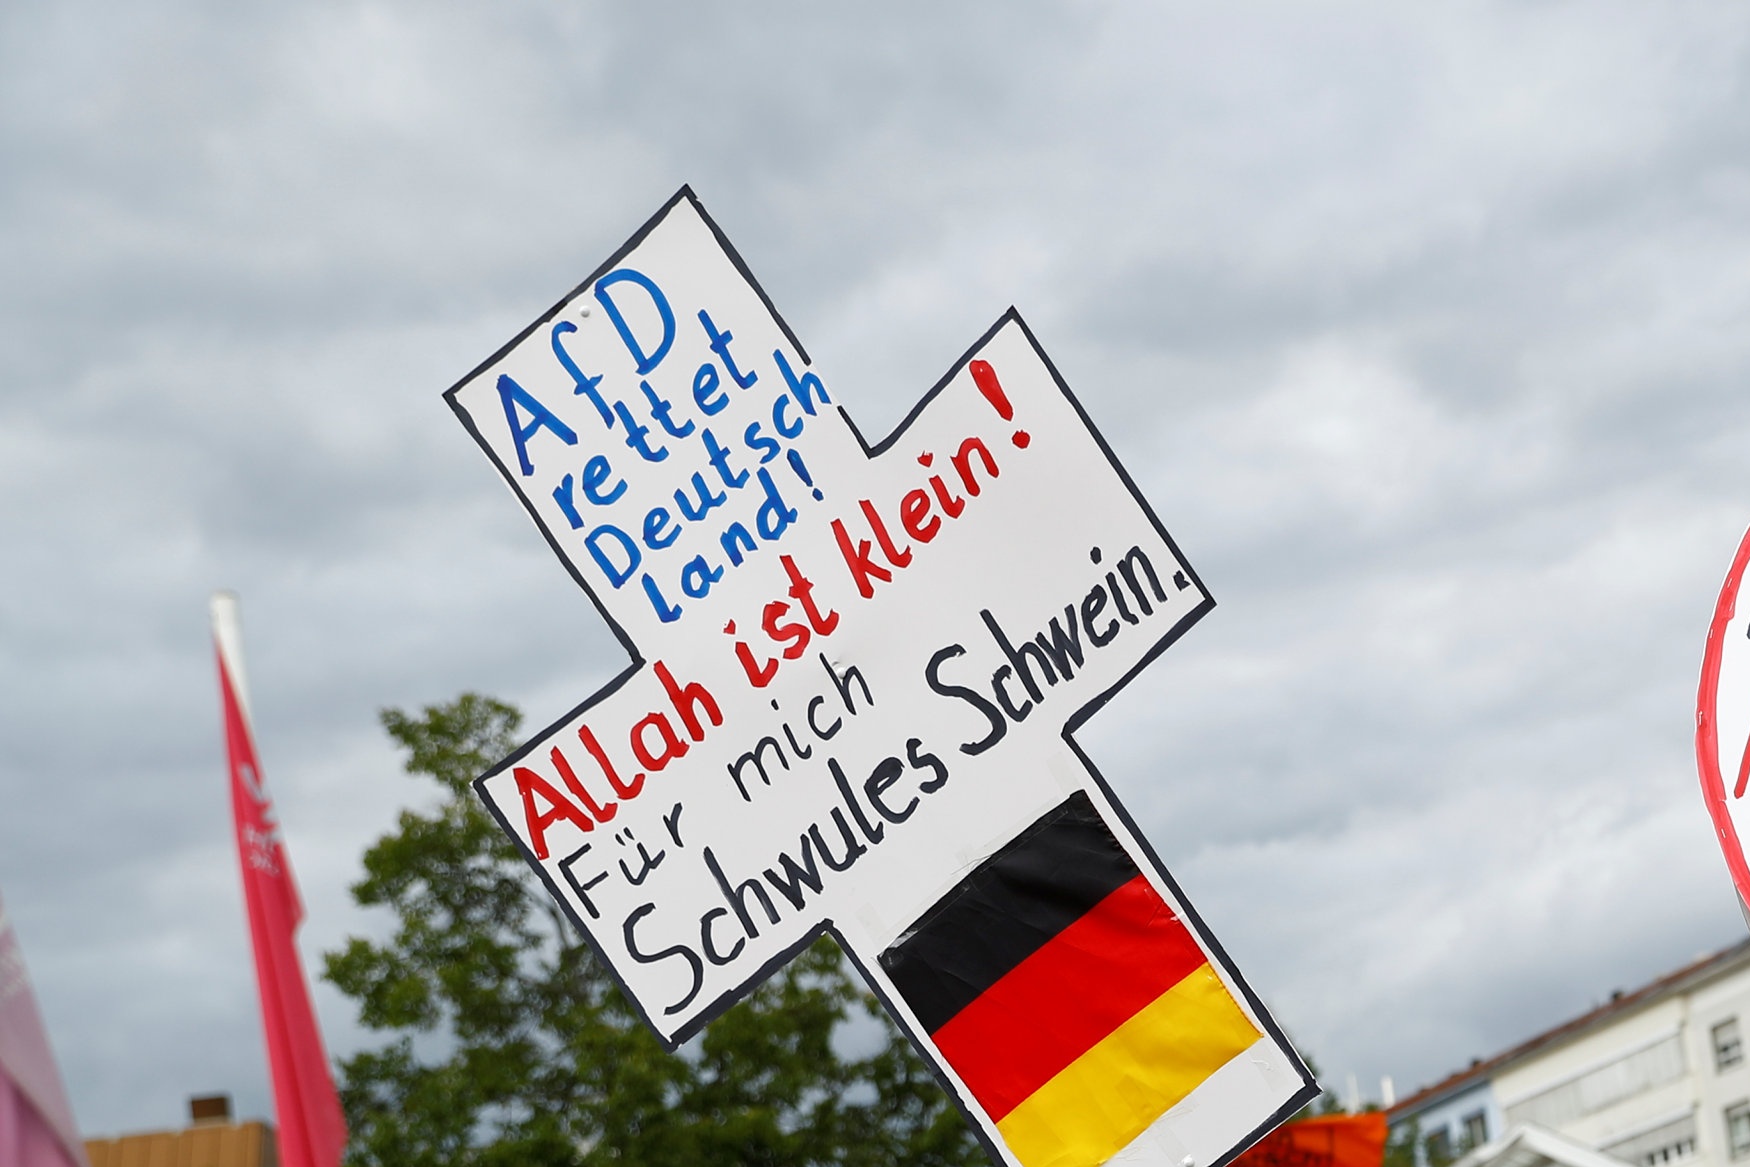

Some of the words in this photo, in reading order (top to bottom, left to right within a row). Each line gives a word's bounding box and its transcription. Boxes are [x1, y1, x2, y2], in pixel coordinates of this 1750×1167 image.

[497, 269, 675, 475] AfD
[553, 310, 757, 529] rettet
[585, 350, 831, 588] Deutsch
[513, 661, 723, 860] Allah
[724, 555, 839, 687] ist
[831, 360, 1031, 598] klein!
[642, 449, 823, 622] land!
[558, 803, 683, 919] Für
[727, 653, 873, 802] mich
[623, 738, 948, 1015] Schwules
[925, 546, 1190, 756] Schwein.
